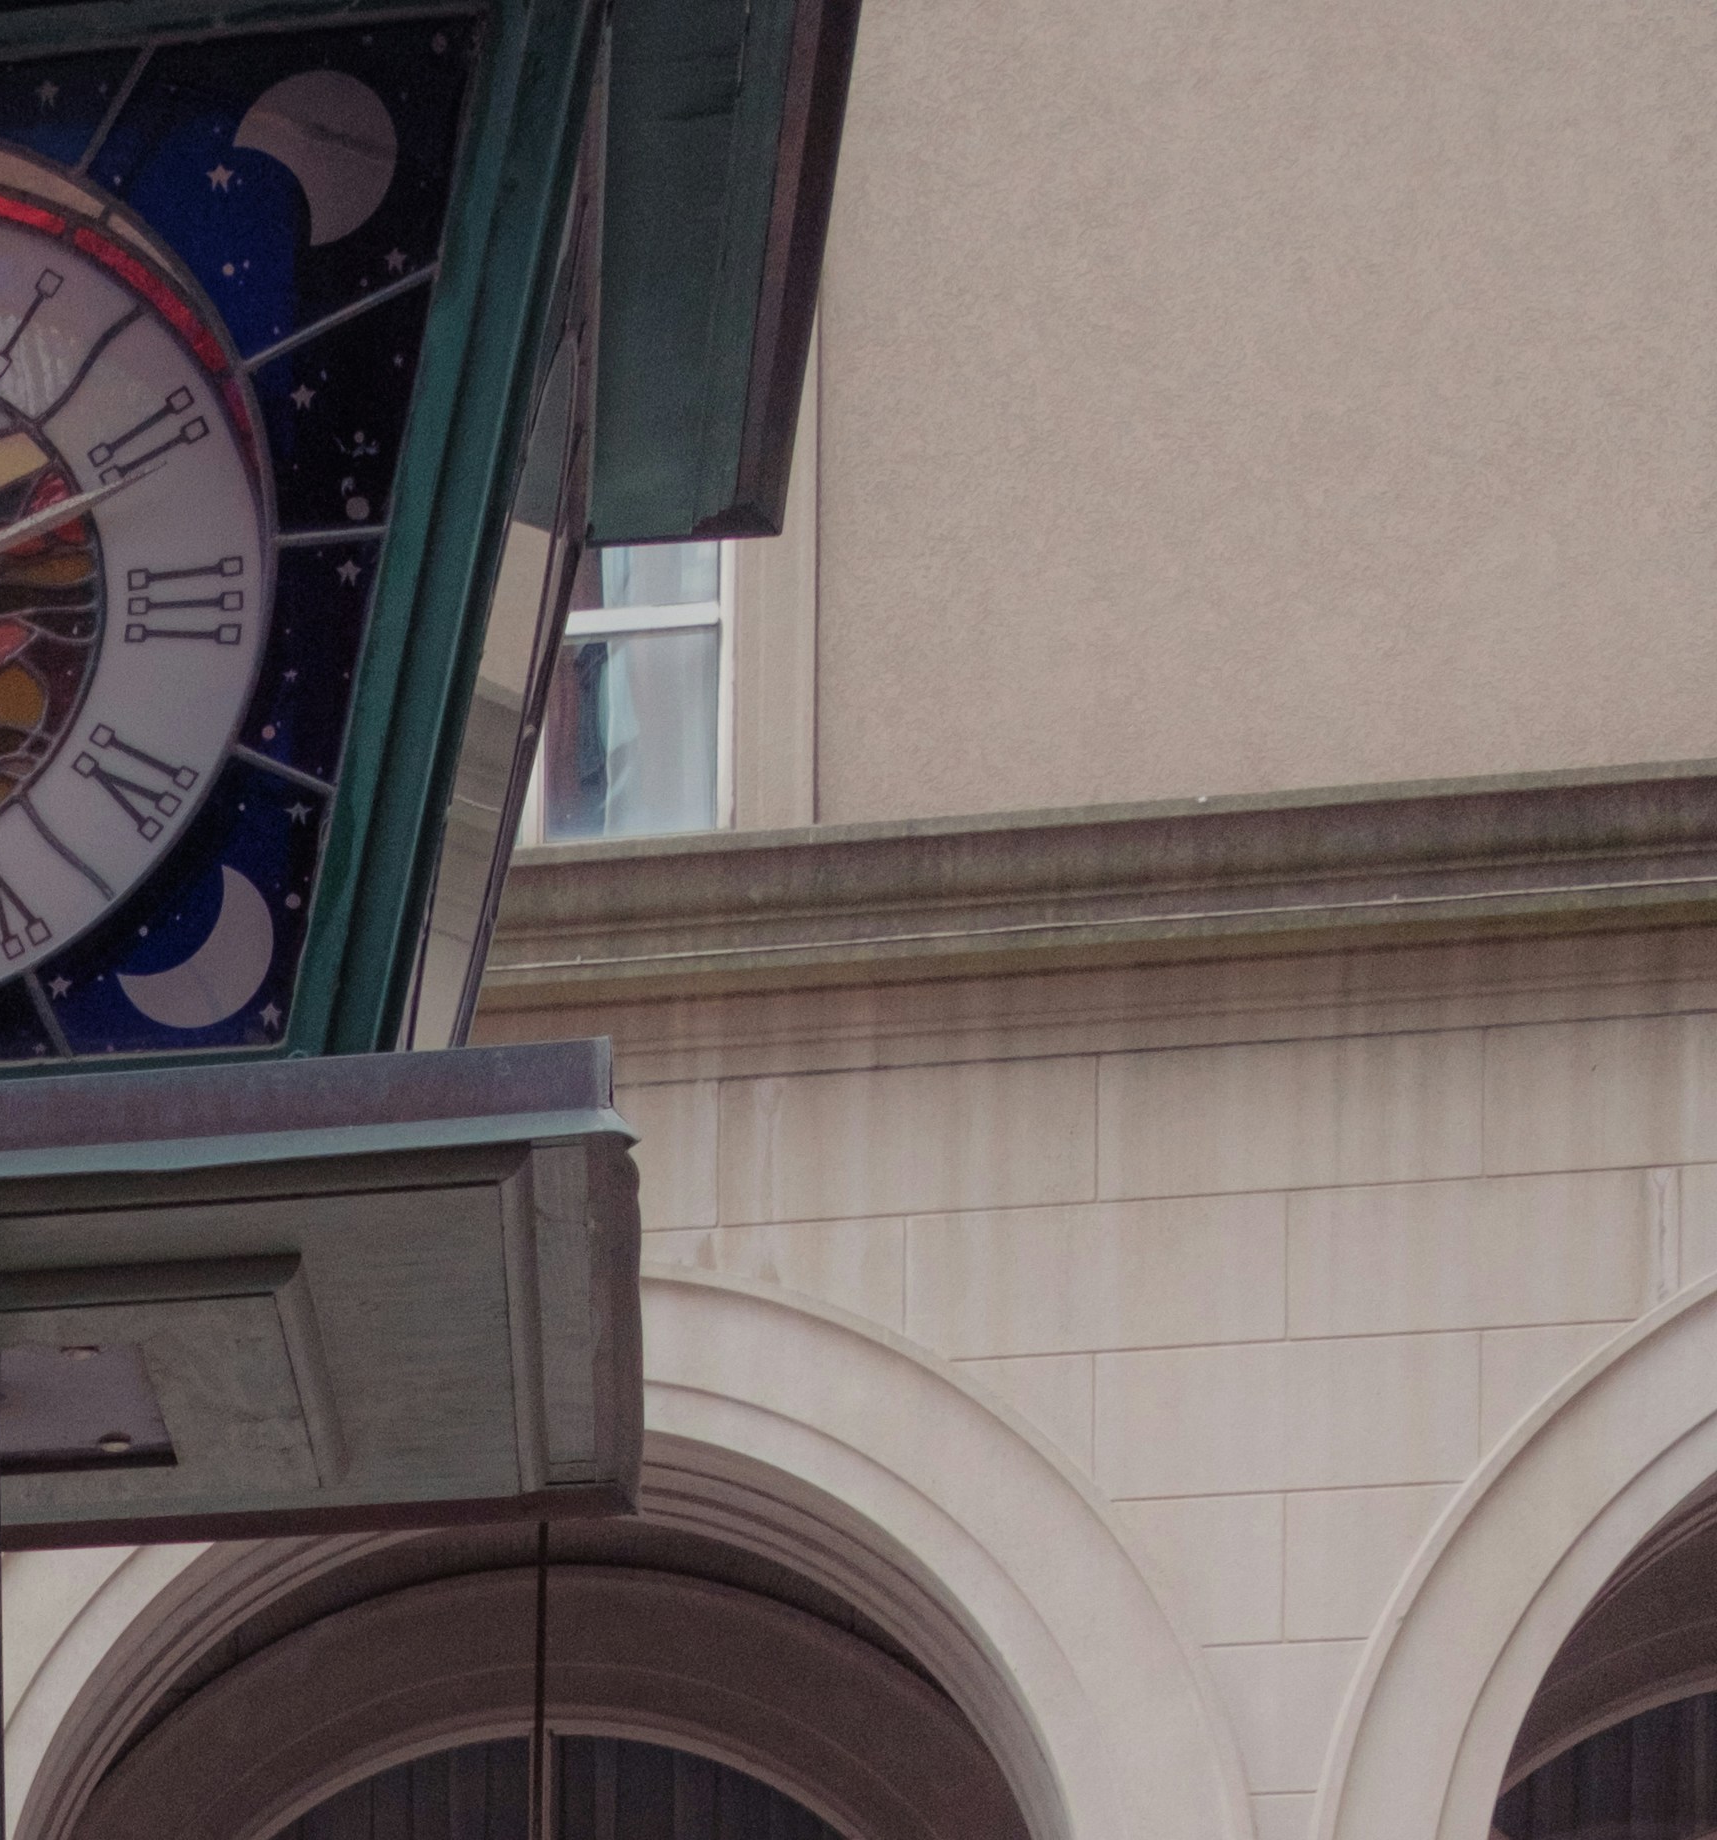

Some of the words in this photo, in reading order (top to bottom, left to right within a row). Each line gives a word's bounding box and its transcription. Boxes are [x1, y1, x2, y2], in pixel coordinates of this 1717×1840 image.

[87, 386, 210, 486] II
[125, 556, 244, 645] III
[72, 723, 199, 842] IV
